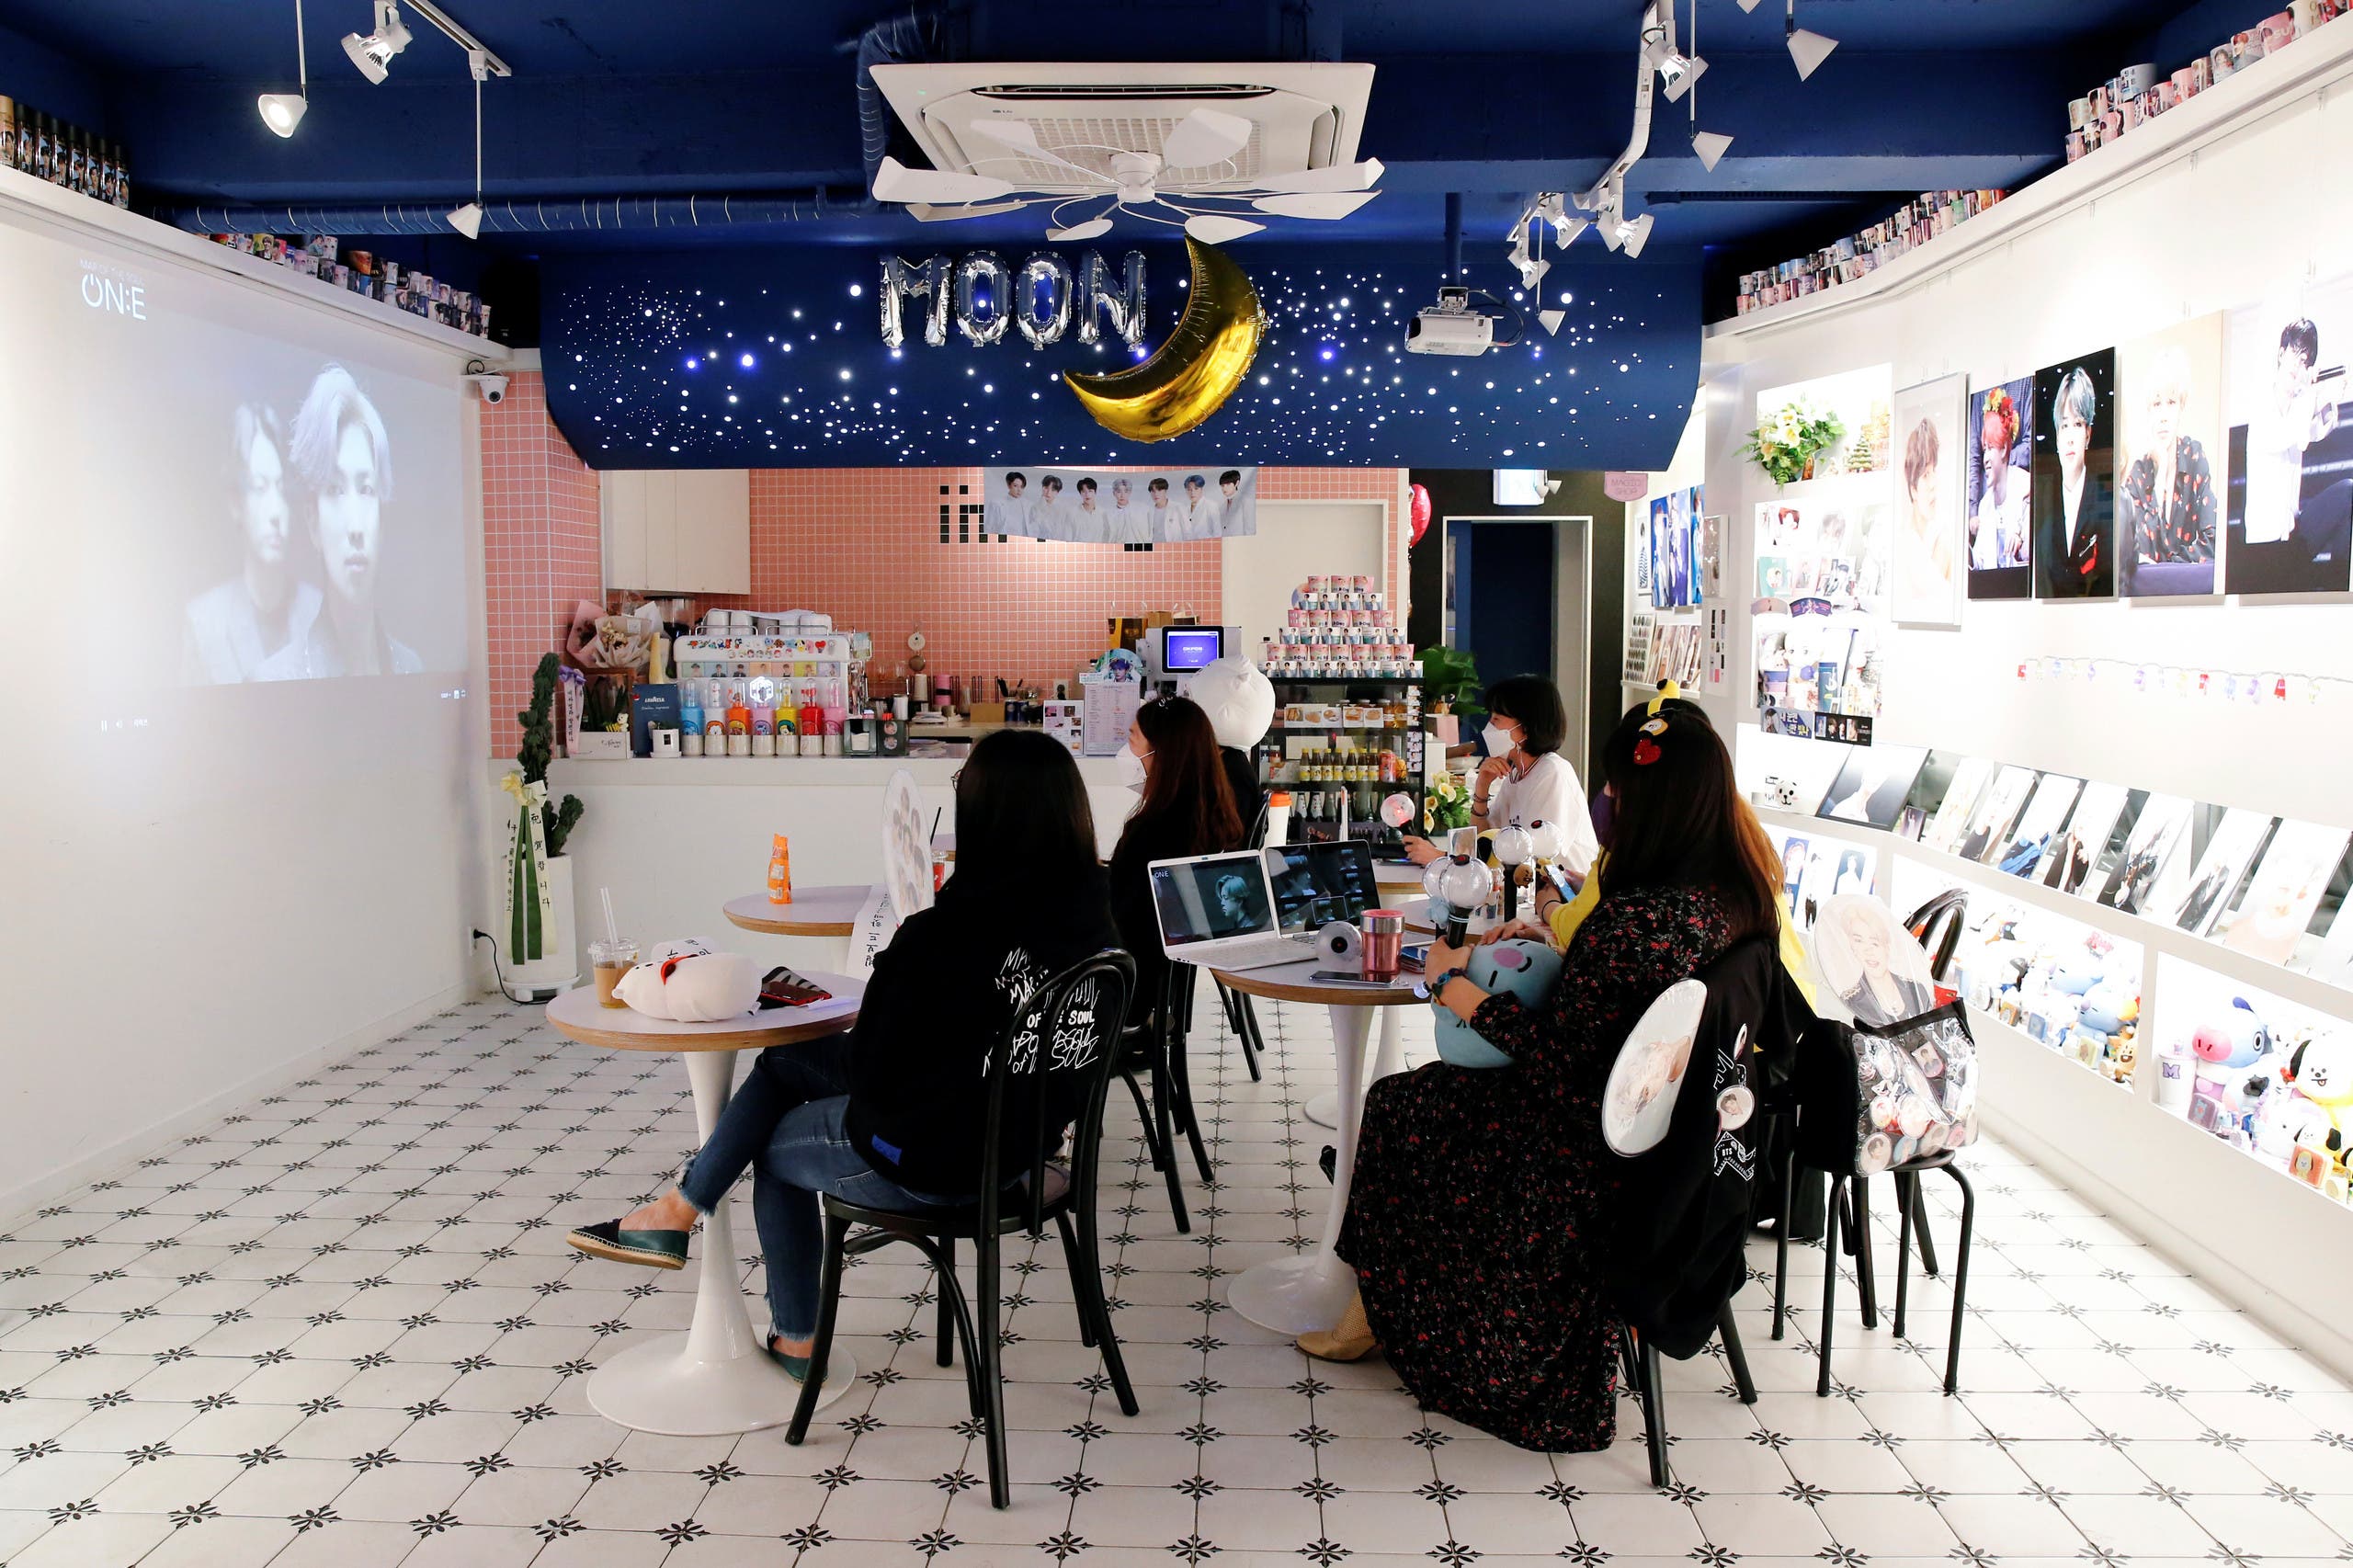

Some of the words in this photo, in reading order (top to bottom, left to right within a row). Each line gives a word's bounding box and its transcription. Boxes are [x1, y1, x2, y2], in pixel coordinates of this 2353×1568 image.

[880, 249, 1147, 353] MOON
[1067, 1010, 1095, 1026] SOUL
[2162, 1062, 2180, 1080] M
[1722, 1147, 1733, 1157] BTS
